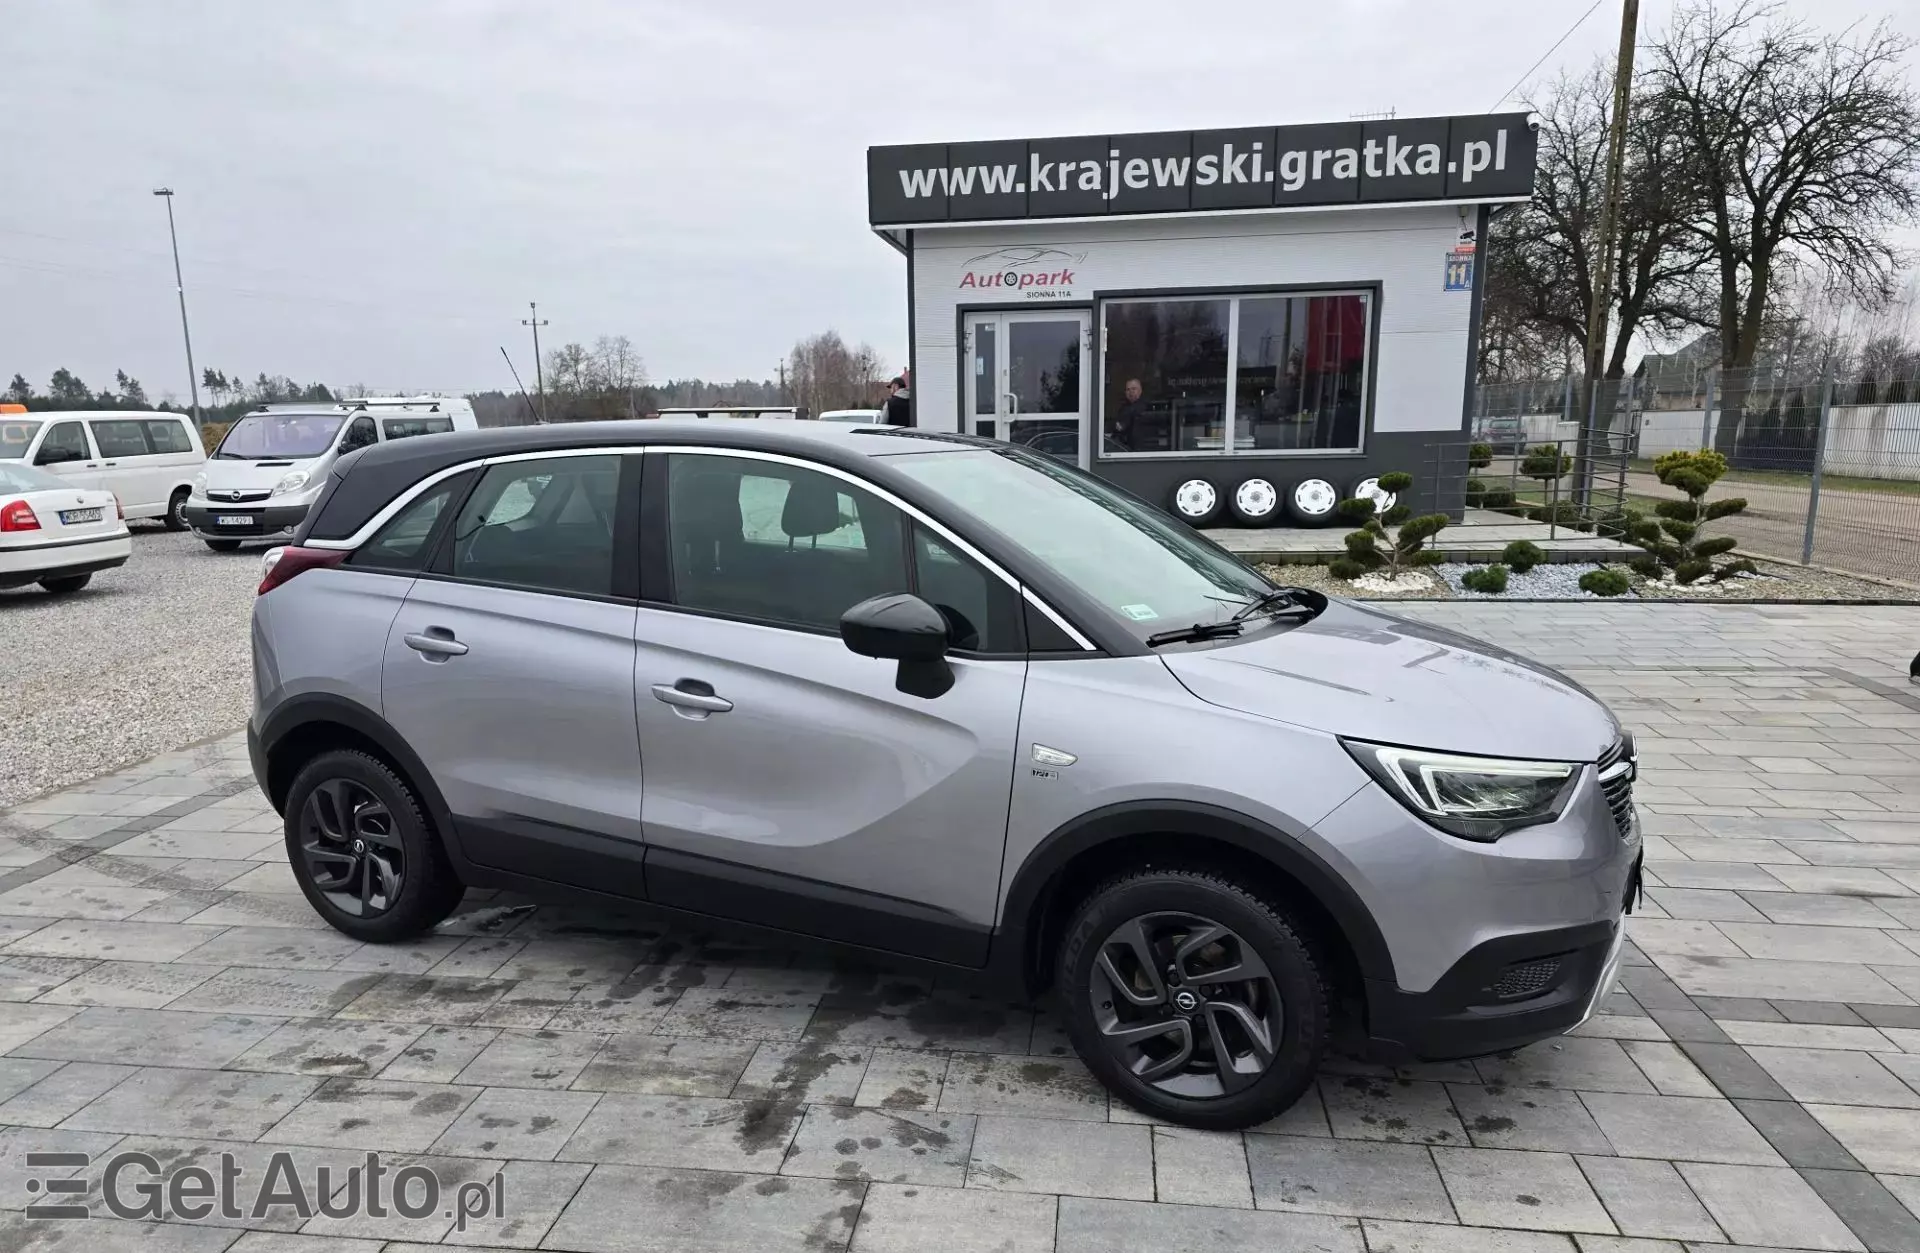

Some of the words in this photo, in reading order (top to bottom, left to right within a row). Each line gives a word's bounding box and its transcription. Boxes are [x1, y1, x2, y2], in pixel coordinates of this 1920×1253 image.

[898, 129, 1507, 200] www.krajewski.gratka.pl
[1448, 264, 1466, 285] 11
[1026, 291, 1056, 299] SIONNA
[1058, 290, 1072, 298] 11A
